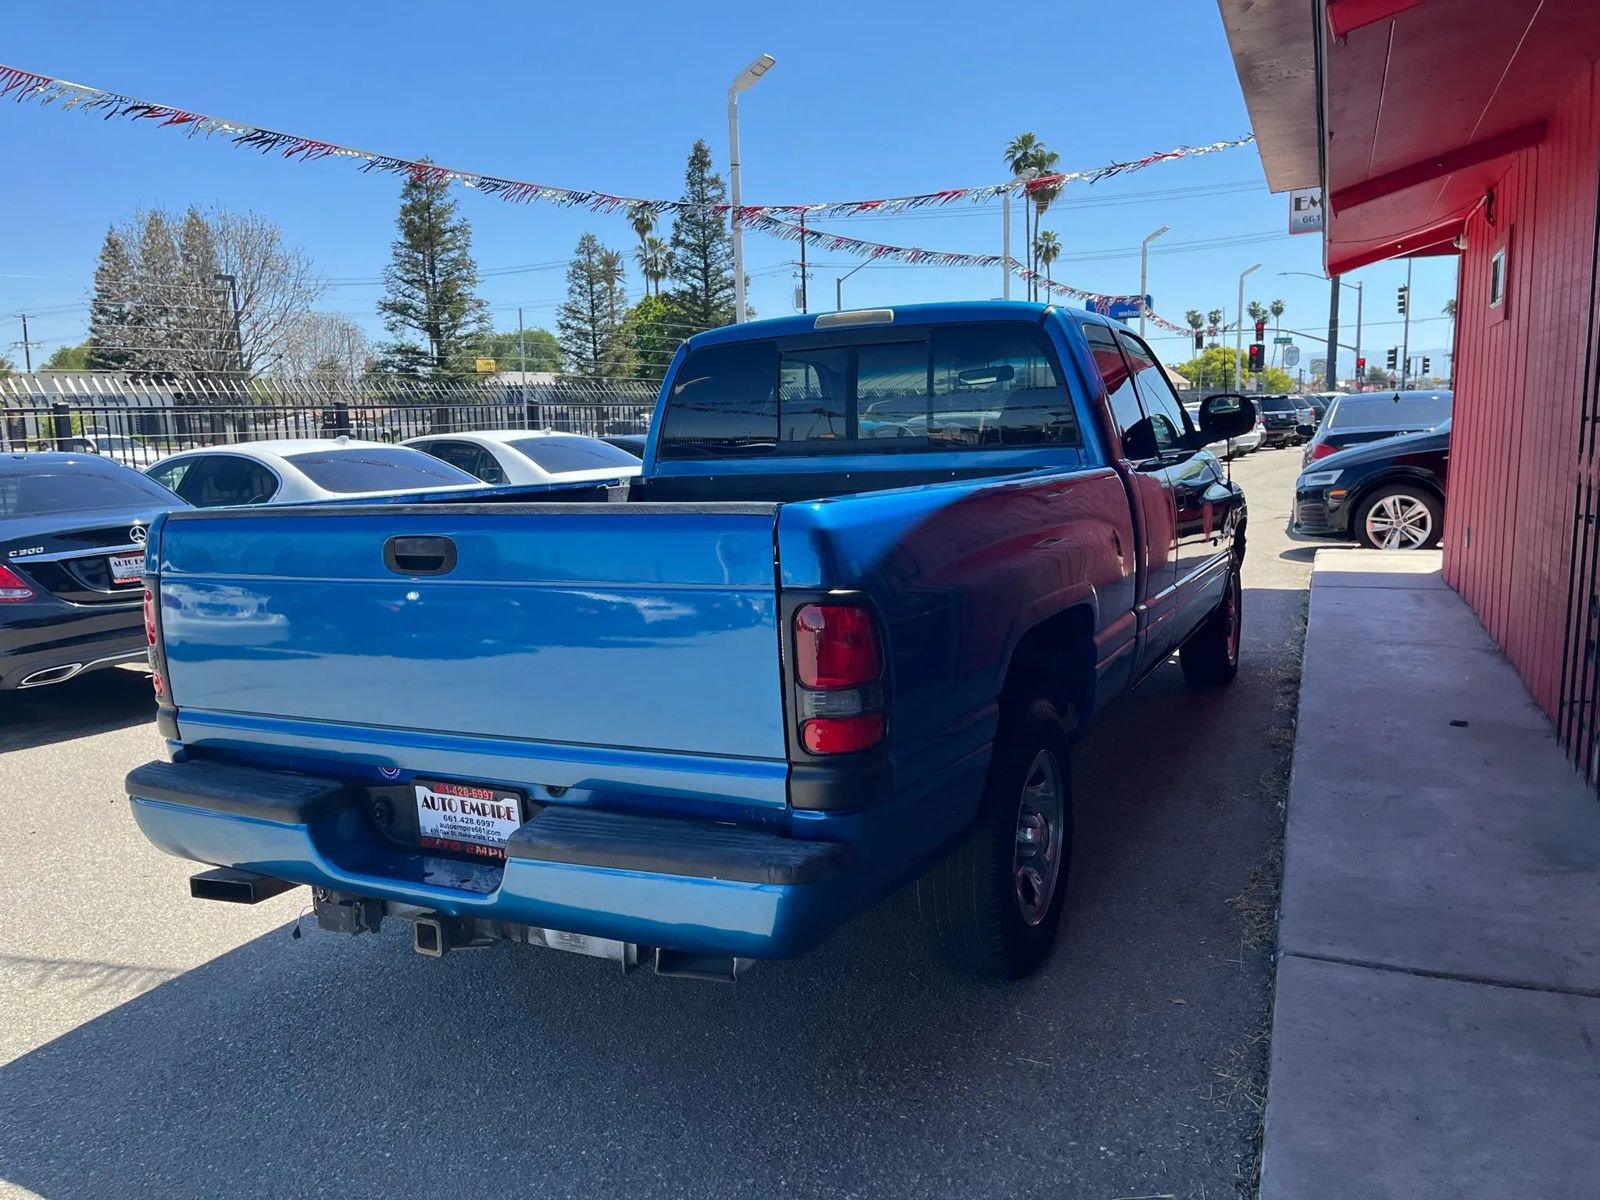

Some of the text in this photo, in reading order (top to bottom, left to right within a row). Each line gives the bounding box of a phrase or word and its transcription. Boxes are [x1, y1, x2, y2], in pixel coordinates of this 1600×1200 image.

[422, 795, 516, 821] AUTO EMPIRE
[439, 822, 501, 836] autoempire661.com
[443, 815, 495, 828] 661.428.6997
[464, 843, 507, 859] EMPI
